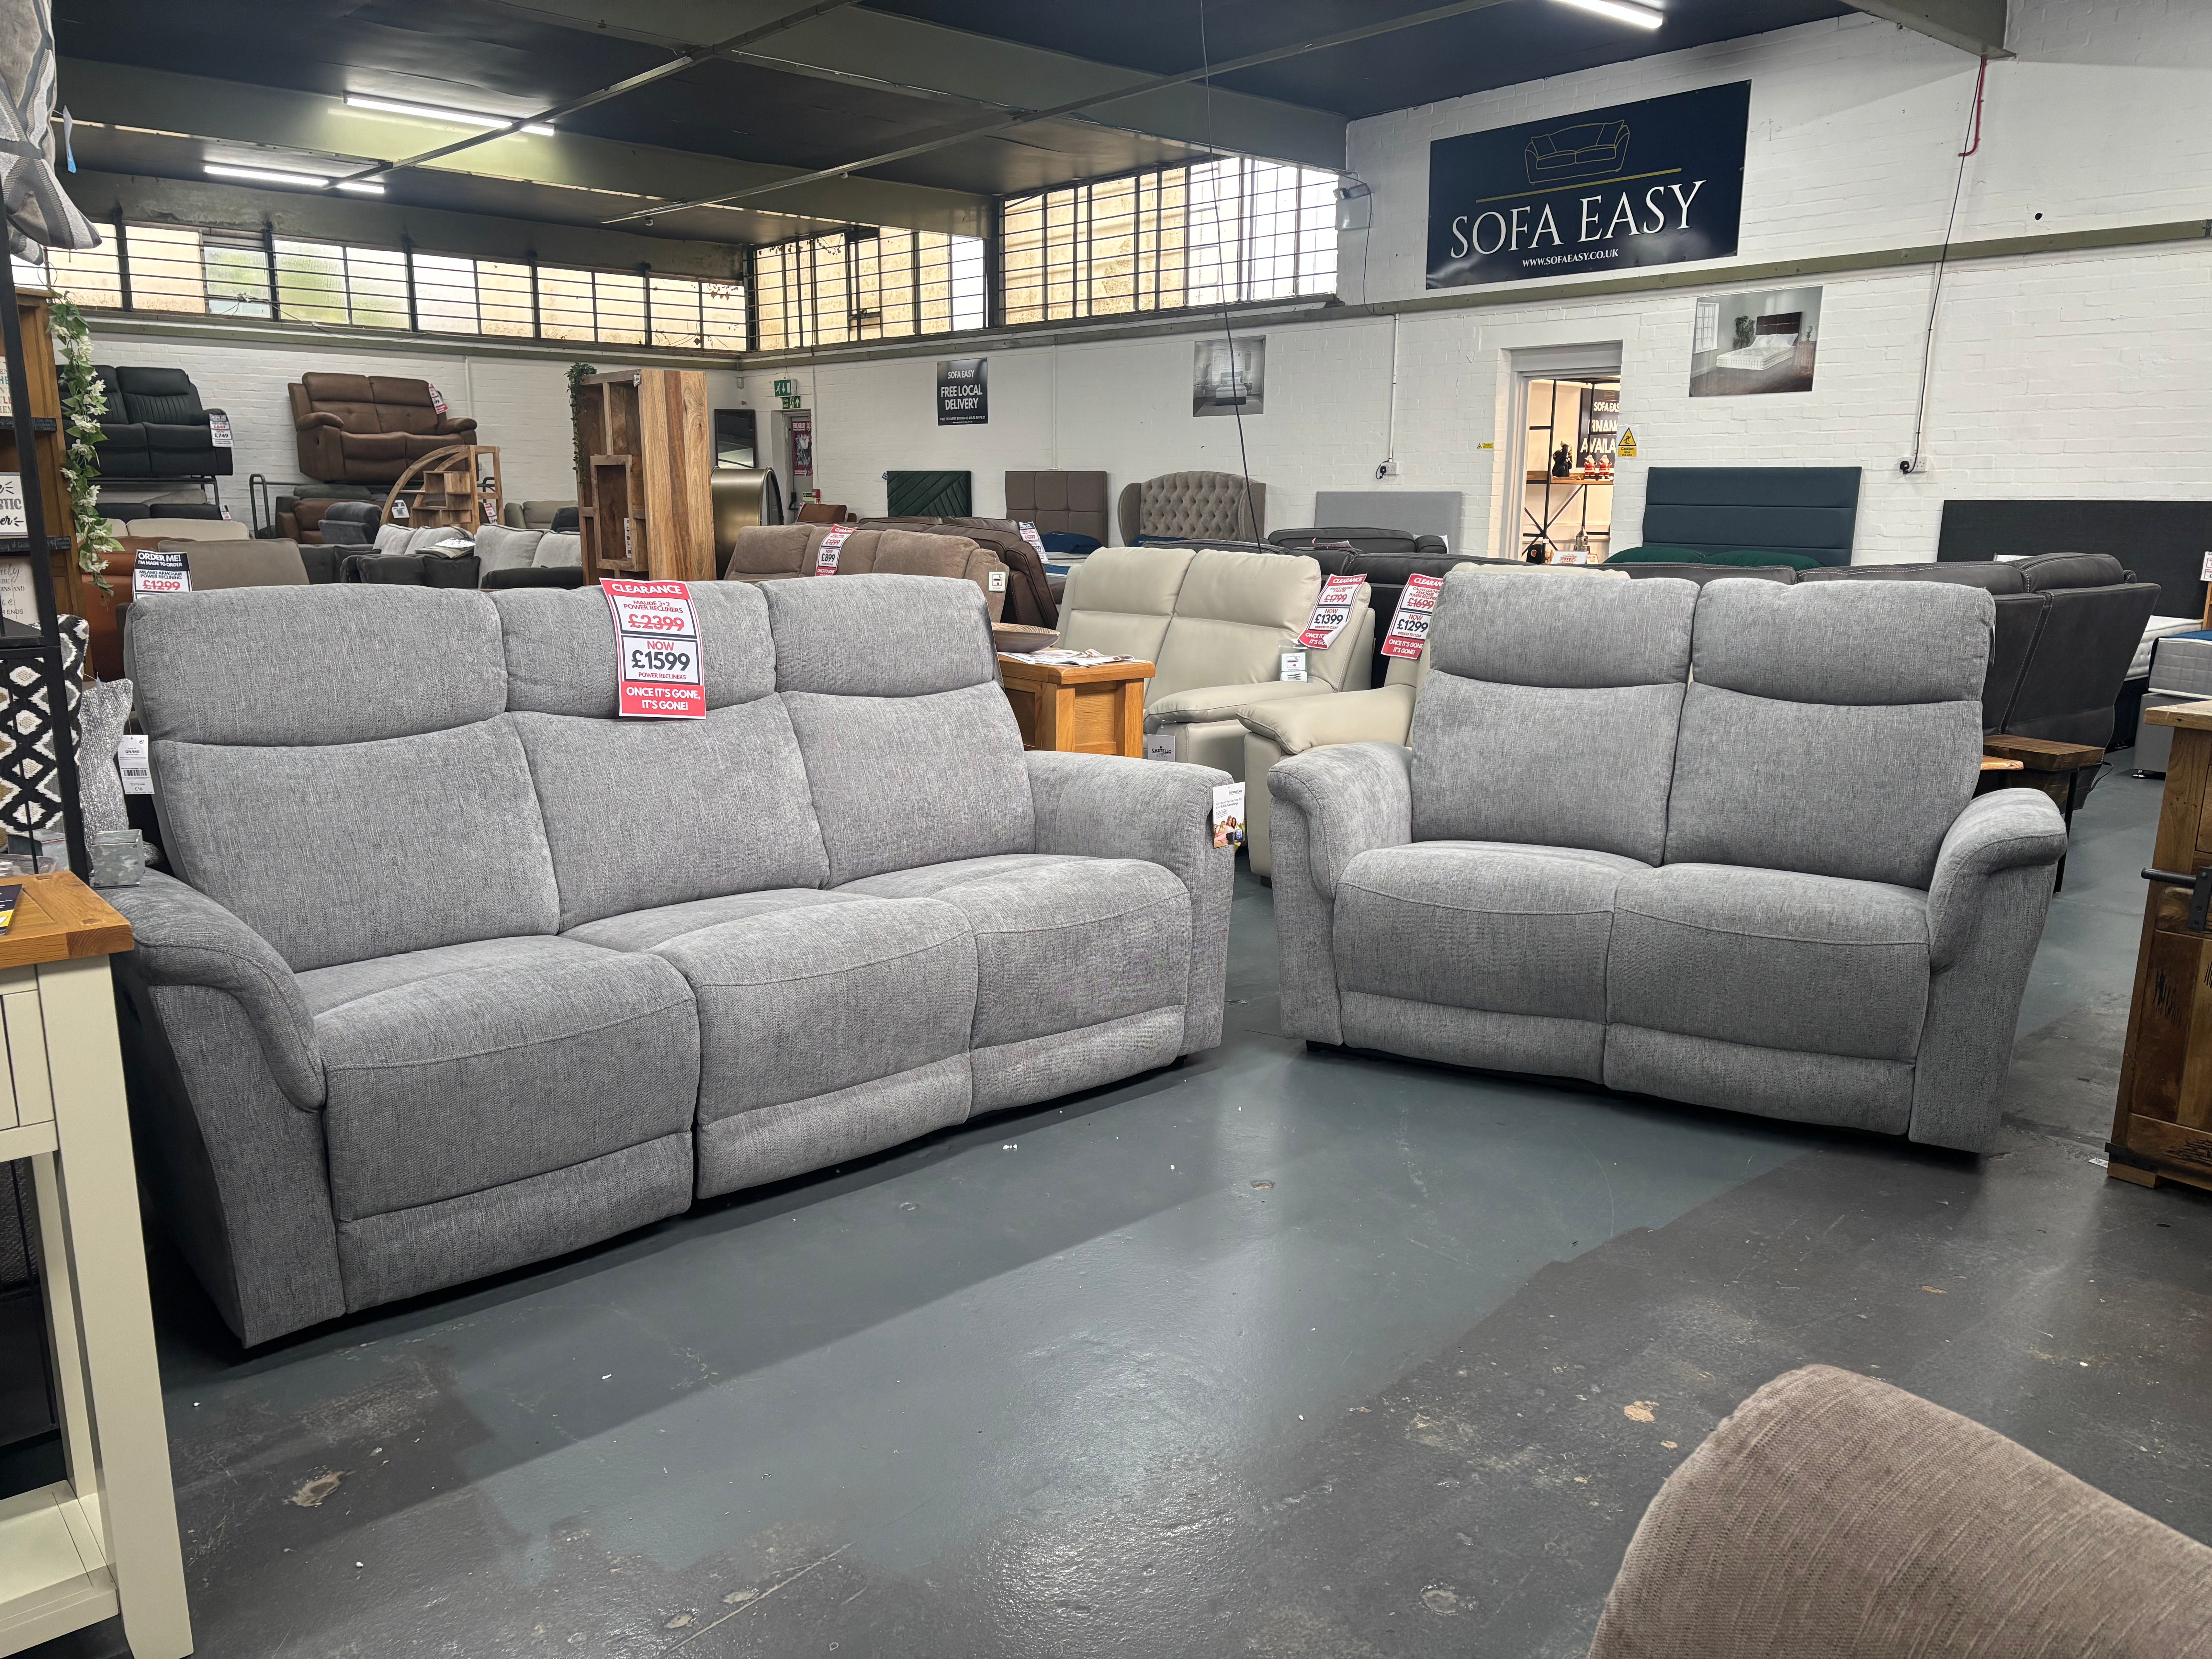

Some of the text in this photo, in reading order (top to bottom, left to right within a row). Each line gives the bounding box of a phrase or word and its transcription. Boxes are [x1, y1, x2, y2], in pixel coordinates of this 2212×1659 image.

[1451, 180, 1706, 259] SOFA EASY
[1522, 248, 1619, 268] WWW.SOFAEASY.CO.UK
[962, 369, 974, 378] EASY
[941, 384, 983, 397] FREE LOCAL
[945, 397, 979, 410] DELIVERY
[1594, 402, 1620, 412] SOFA EAS
[1580, 438, 1616, 453] AVAILA
[138, 553, 165, 562] ORDER
[821, 553, 835, 562] £899
[143, 580, 180, 590] £1299
[1413, 577, 1443, 587] CLEARAN
[611, 583, 682, 594] CLEARANCE
[1324, 594, 1348, 603] £1799
[1407, 598, 1434, 609] £1699
[628, 613, 685, 632] £2399
[1314, 614, 1343, 625] £1399
[1396, 619, 1428, 632] £1299
[647, 641, 674, 651] NOW
[631, 650, 690, 671] £1599
[626, 687, 701, 700] ONCE IT'S GONE,
[642, 700, 689, 710] IT'S GONE!
